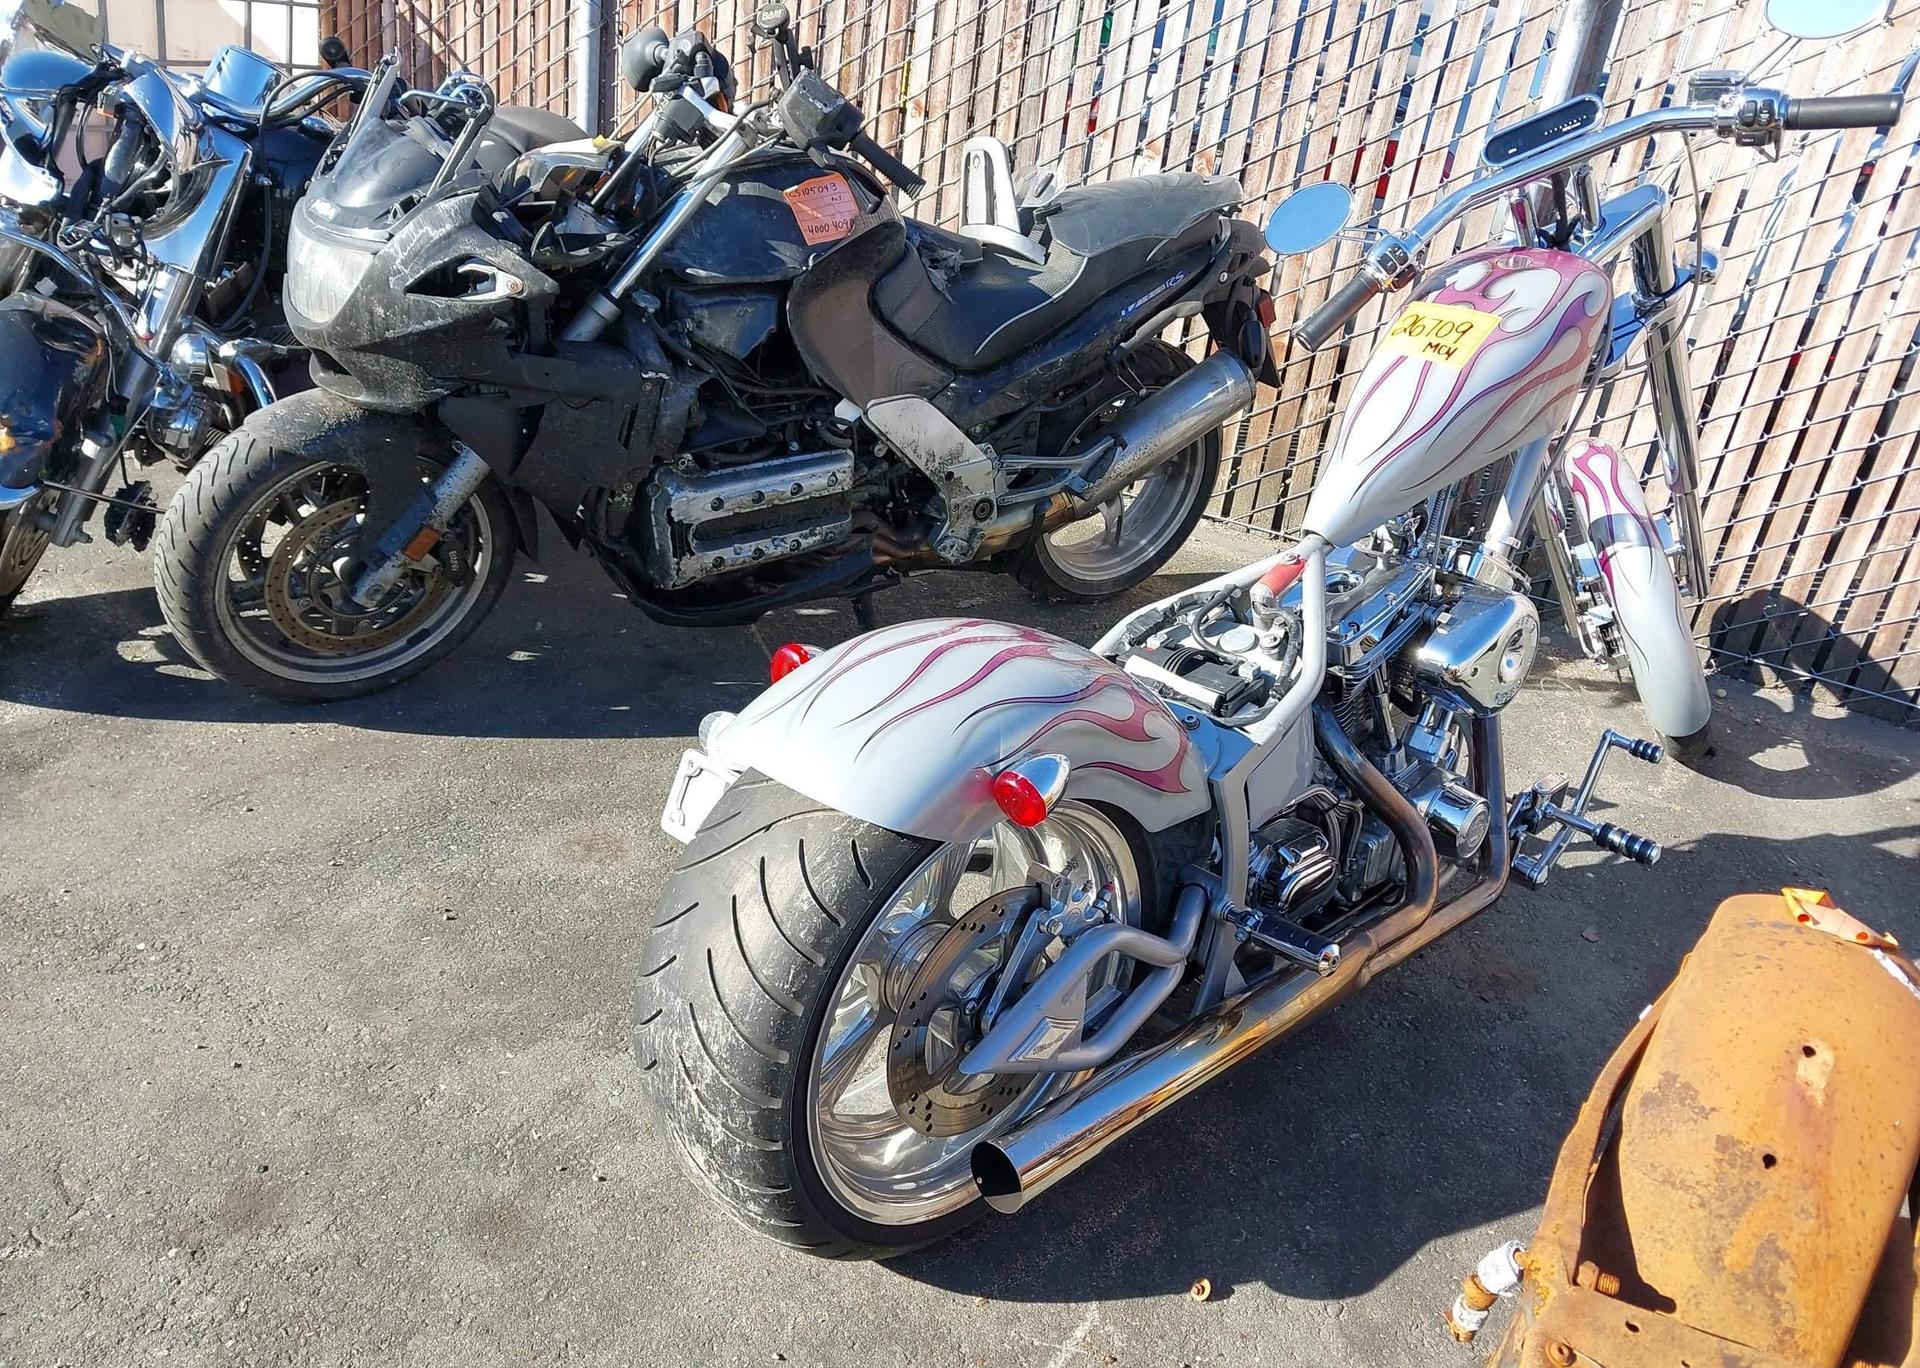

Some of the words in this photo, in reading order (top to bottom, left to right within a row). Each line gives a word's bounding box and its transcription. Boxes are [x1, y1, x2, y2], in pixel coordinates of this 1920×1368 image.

[761, 9, 782, 21] RAM
[808, 222, 830, 234] 4000
[1391, 314, 1474, 344] 26709
